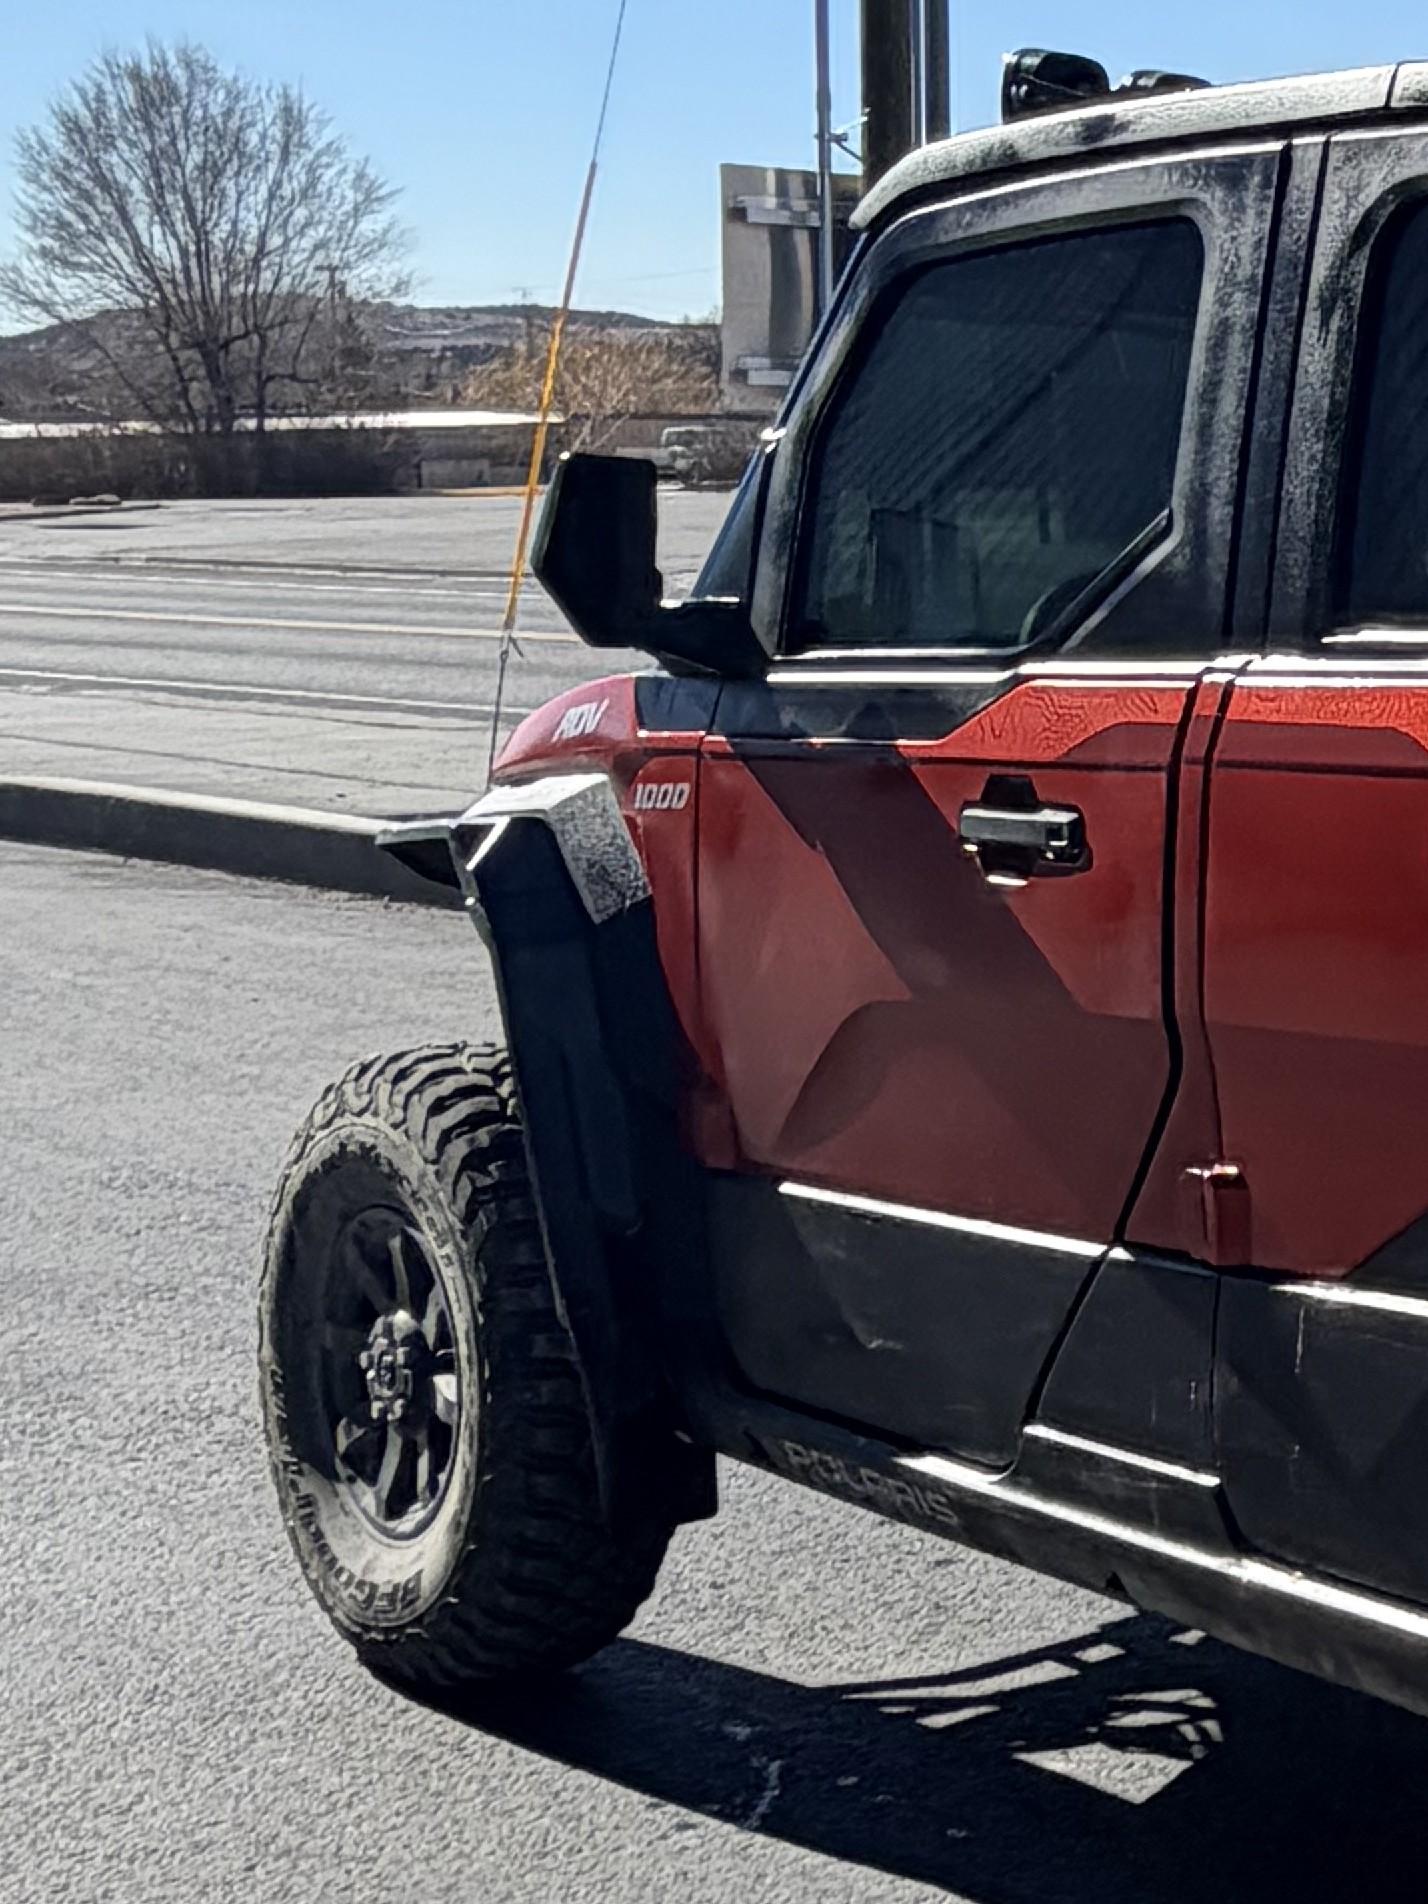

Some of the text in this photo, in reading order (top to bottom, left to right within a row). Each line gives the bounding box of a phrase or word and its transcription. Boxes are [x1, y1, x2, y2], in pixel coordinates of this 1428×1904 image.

[551, 698, 610, 743] ADV
[632, 781, 692, 811] 1000
[779, 1437, 960, 1527] POLARIS
